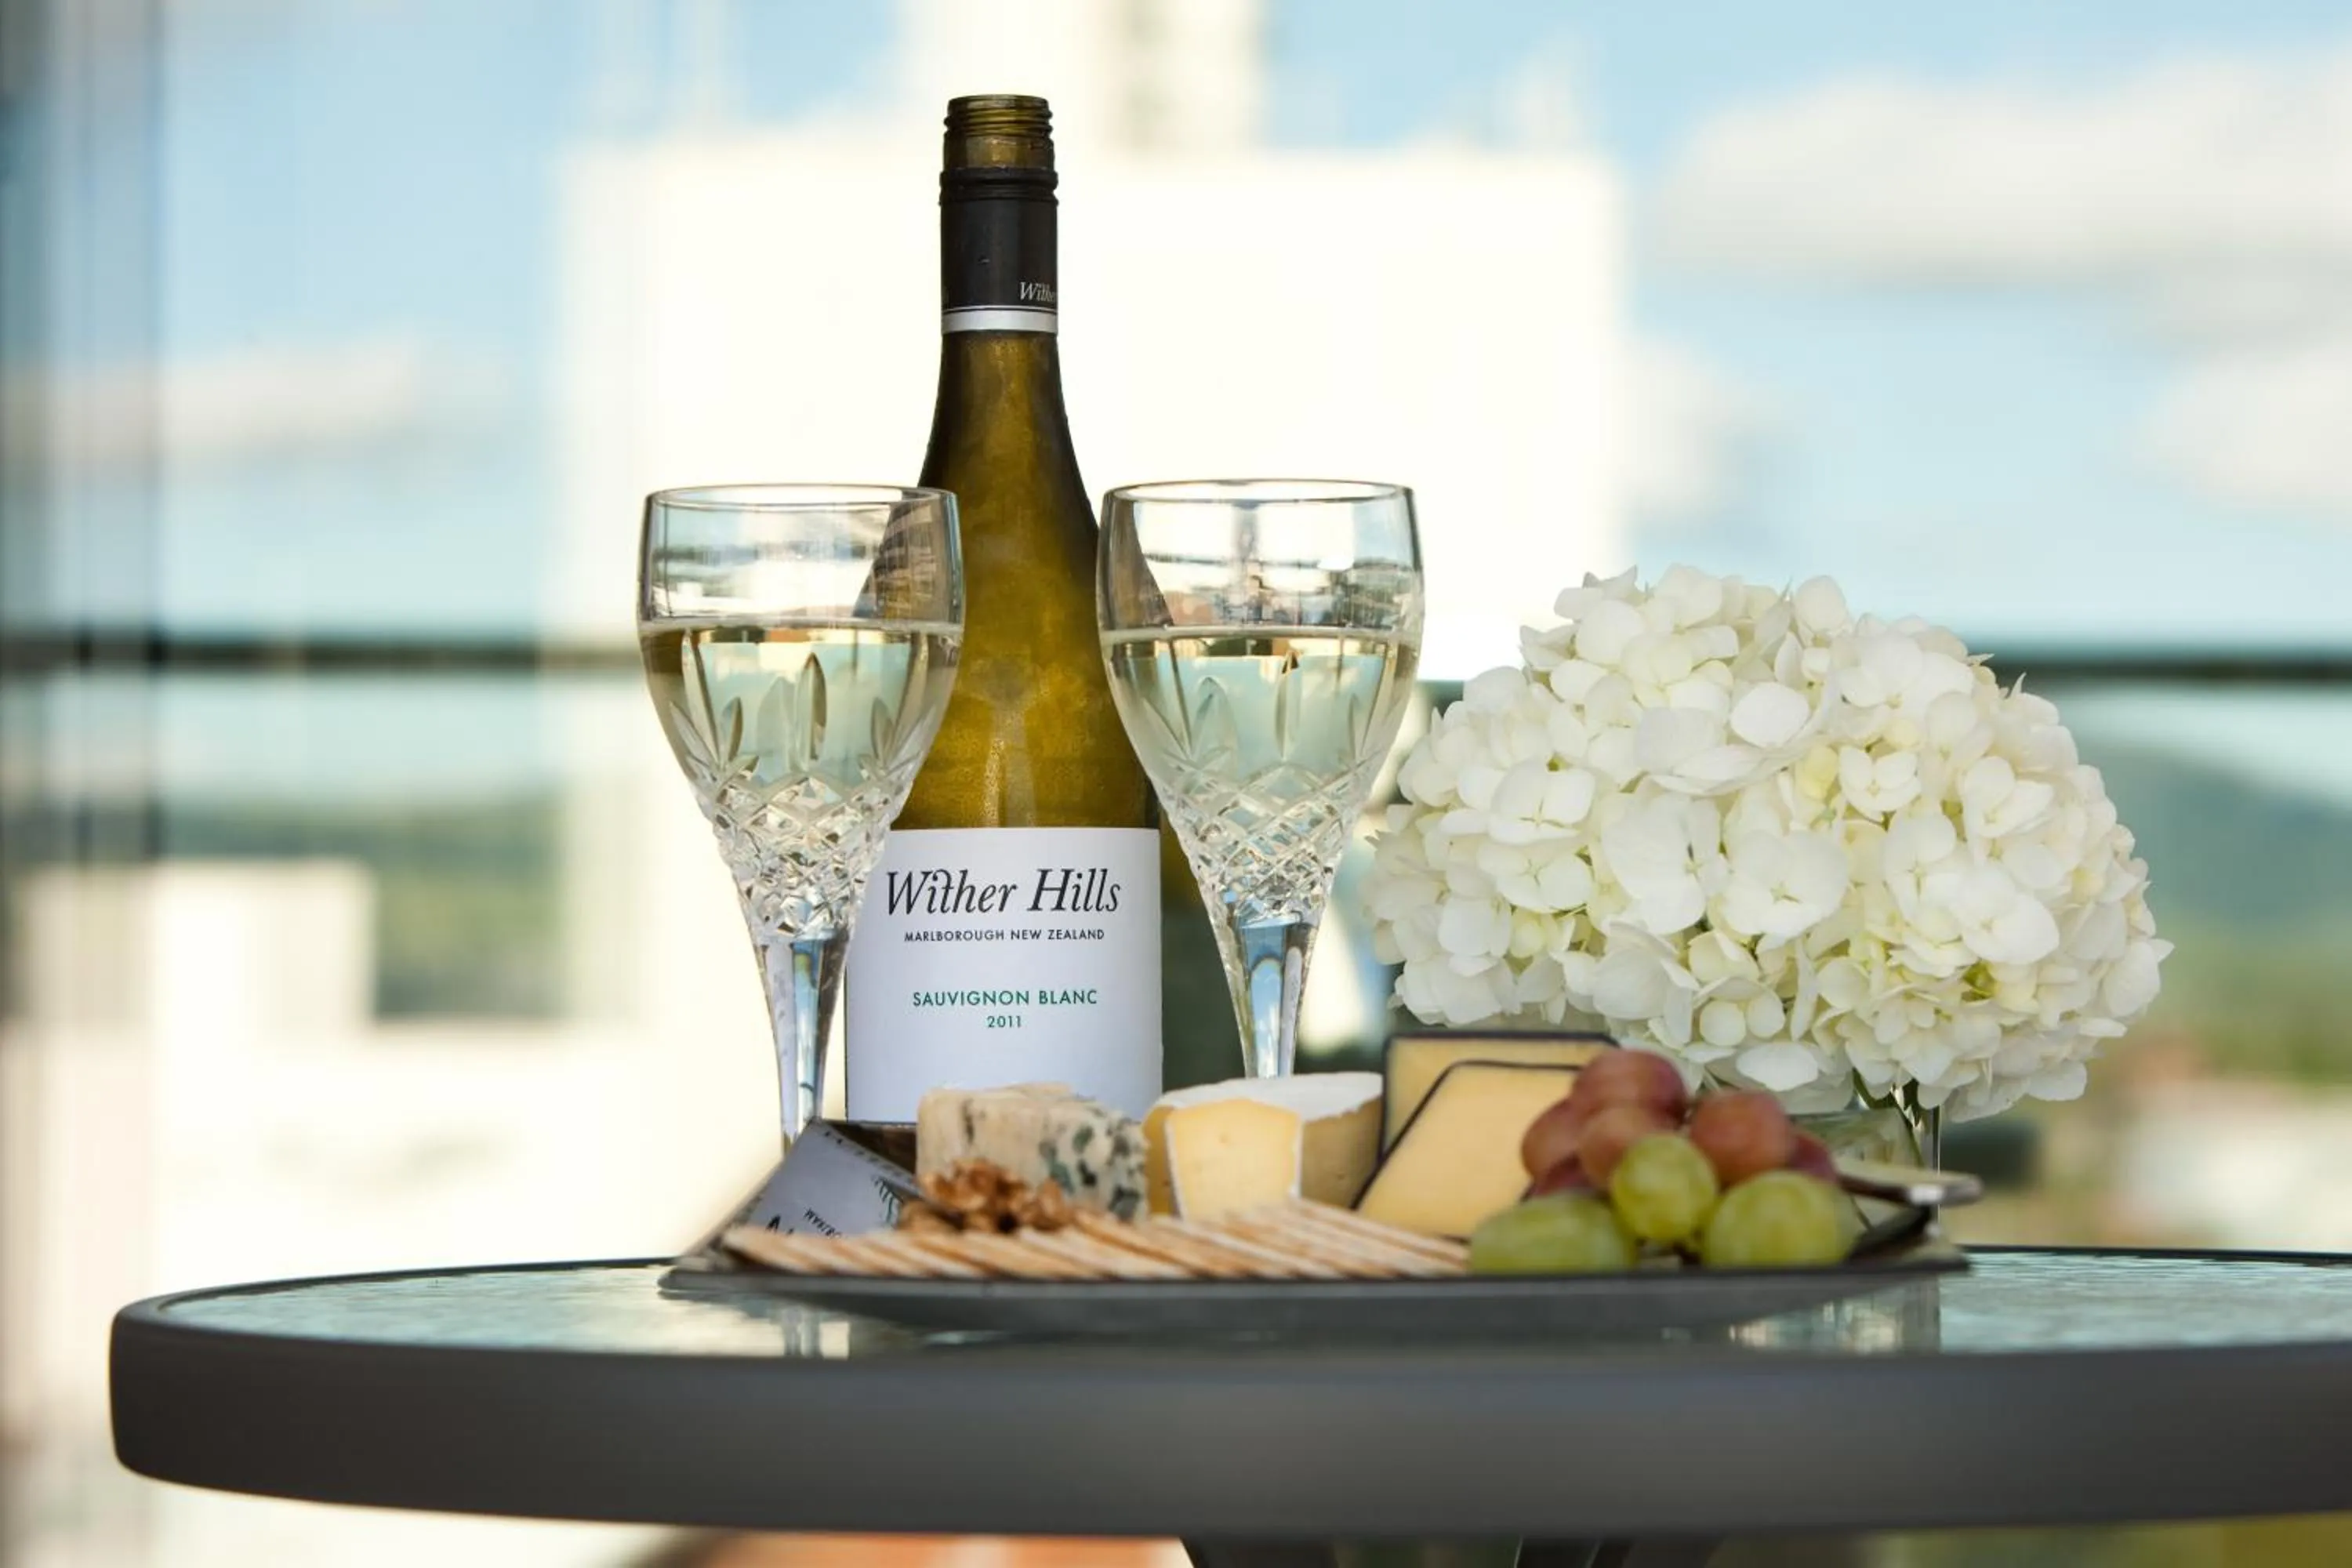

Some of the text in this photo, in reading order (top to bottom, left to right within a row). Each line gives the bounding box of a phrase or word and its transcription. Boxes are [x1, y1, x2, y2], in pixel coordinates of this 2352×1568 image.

[886, 867, 1122, 916] Wither Hills
[904, 928, 1105, 942] MARLBOROUGH NEW ZEALAND
[913, 989, 1098, 1007] SAUVIGNON BLANC
[986, 1015, 1022, 1029] 2011
